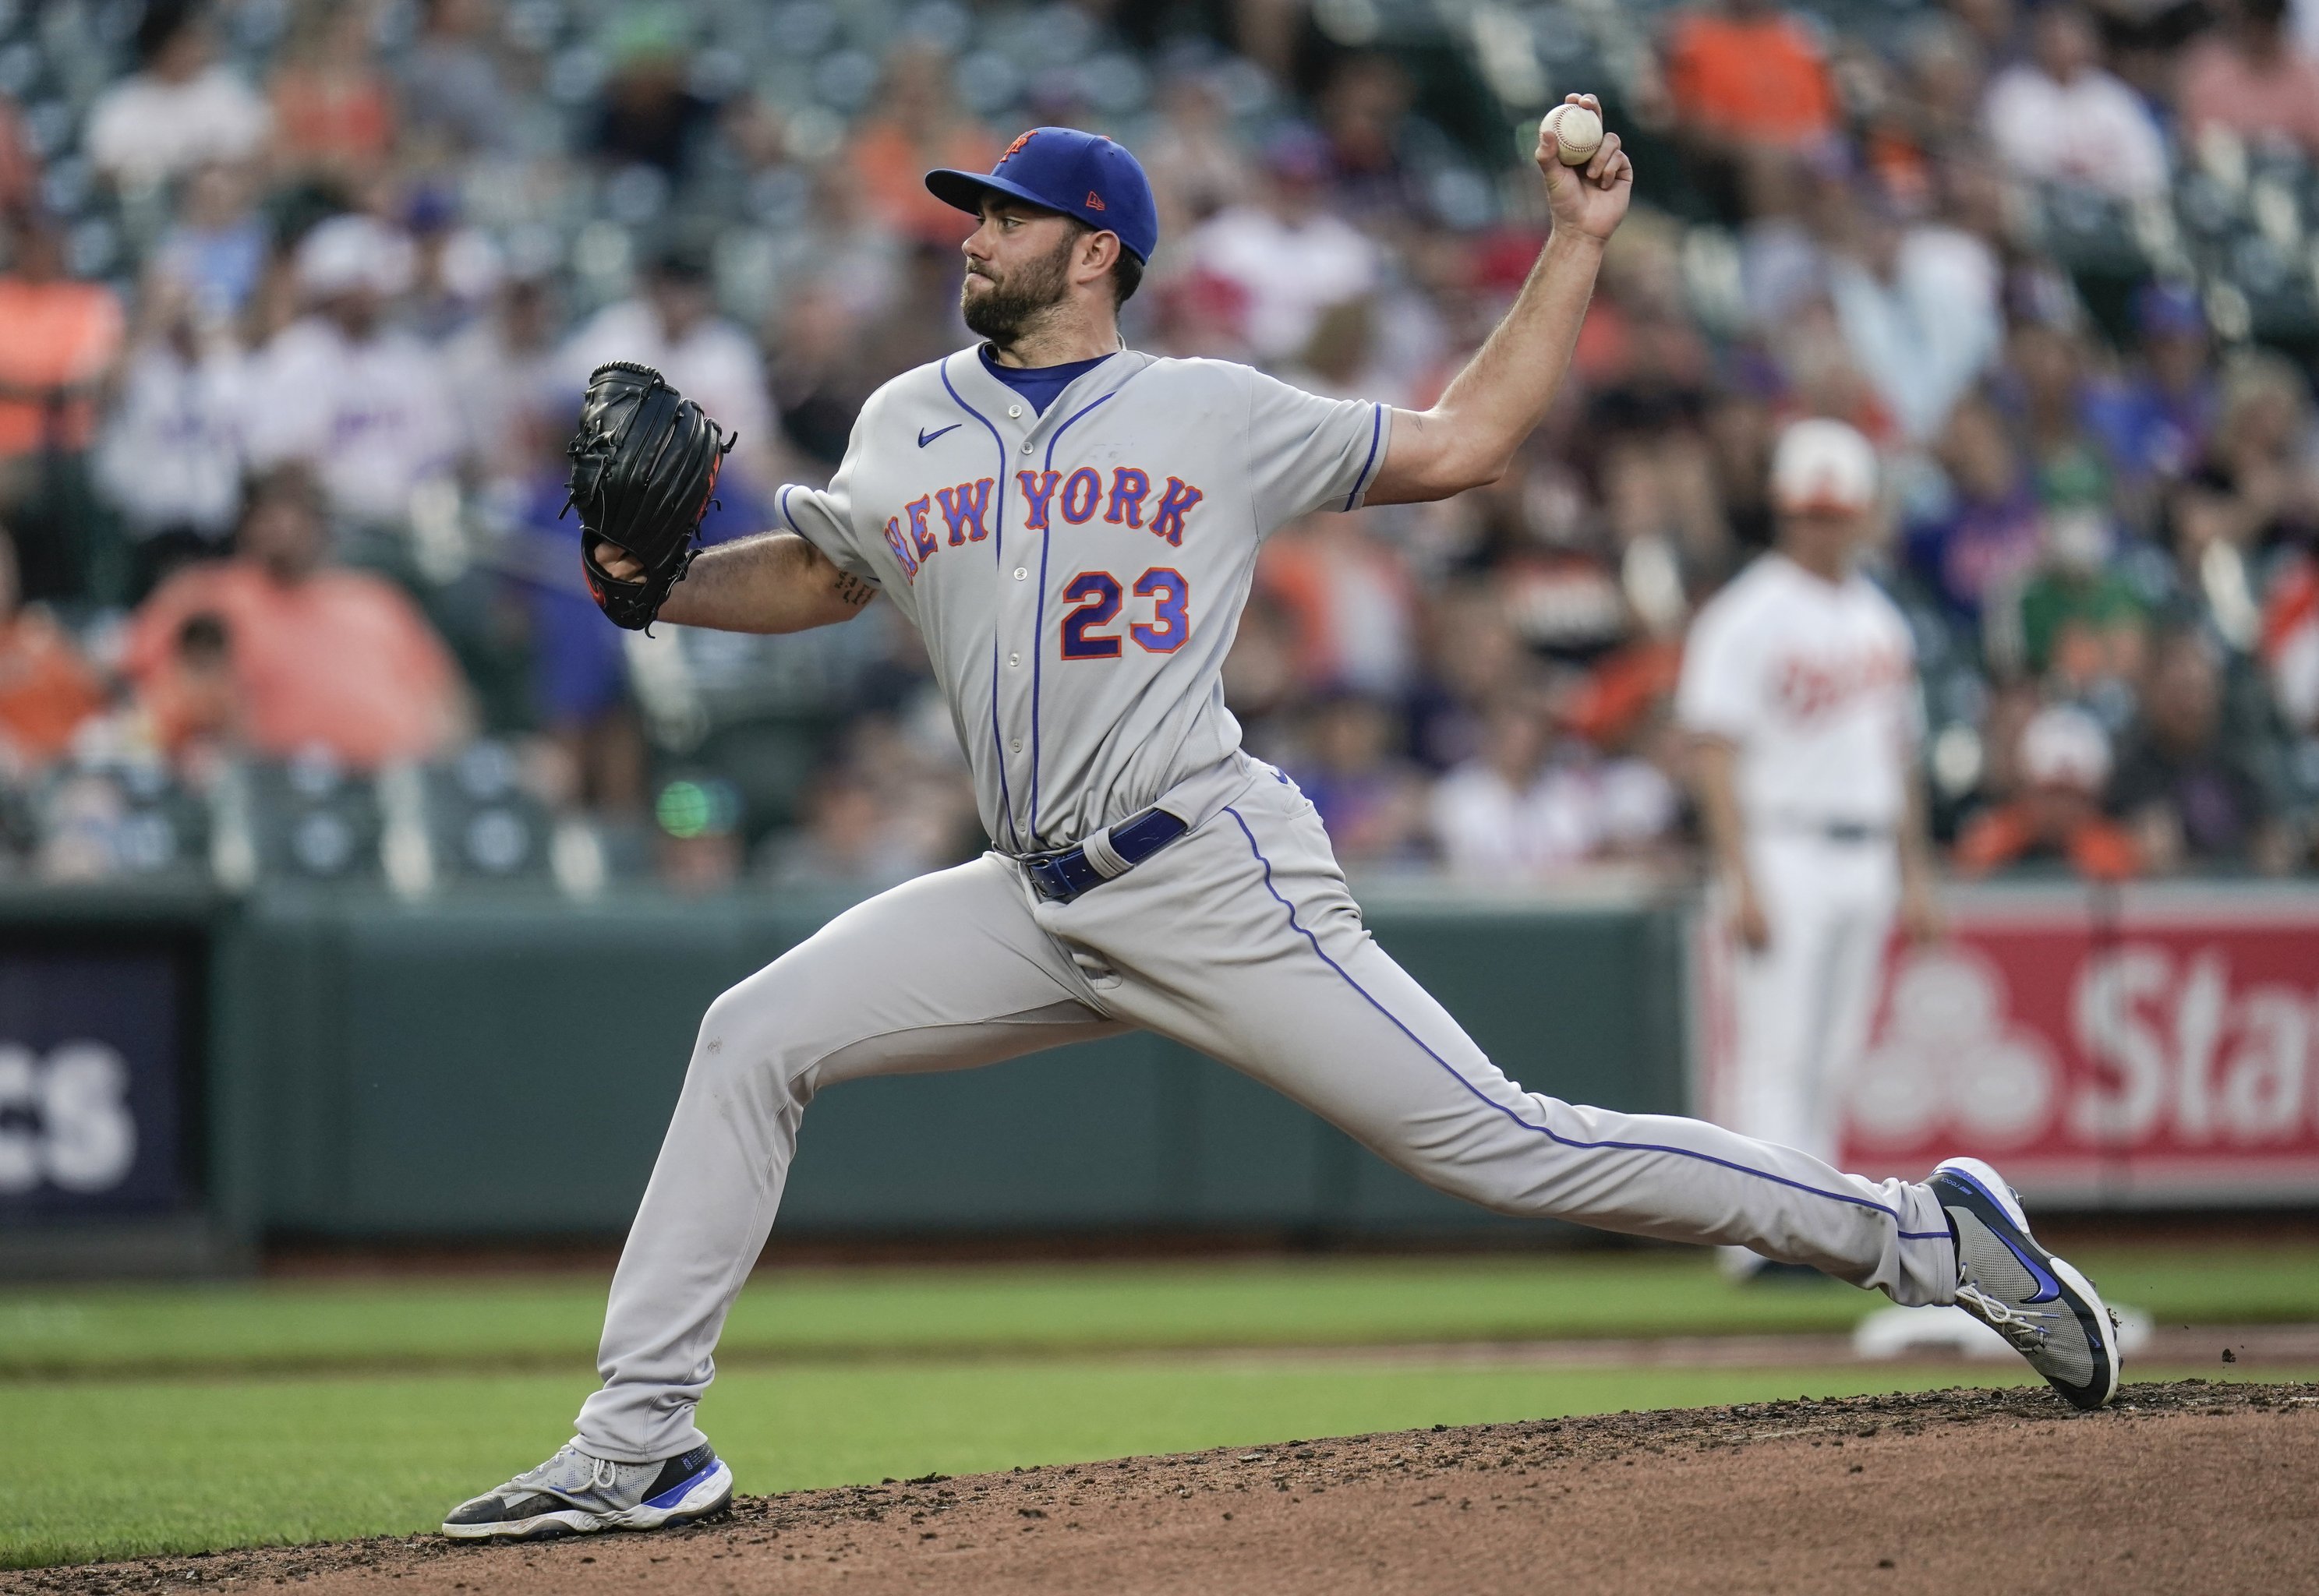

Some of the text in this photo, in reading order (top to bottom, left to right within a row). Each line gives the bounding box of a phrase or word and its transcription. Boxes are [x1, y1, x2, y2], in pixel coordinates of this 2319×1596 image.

[884, 466, 1204, 586] NEW YORK
[1060, 567, 1190, 662] 23
